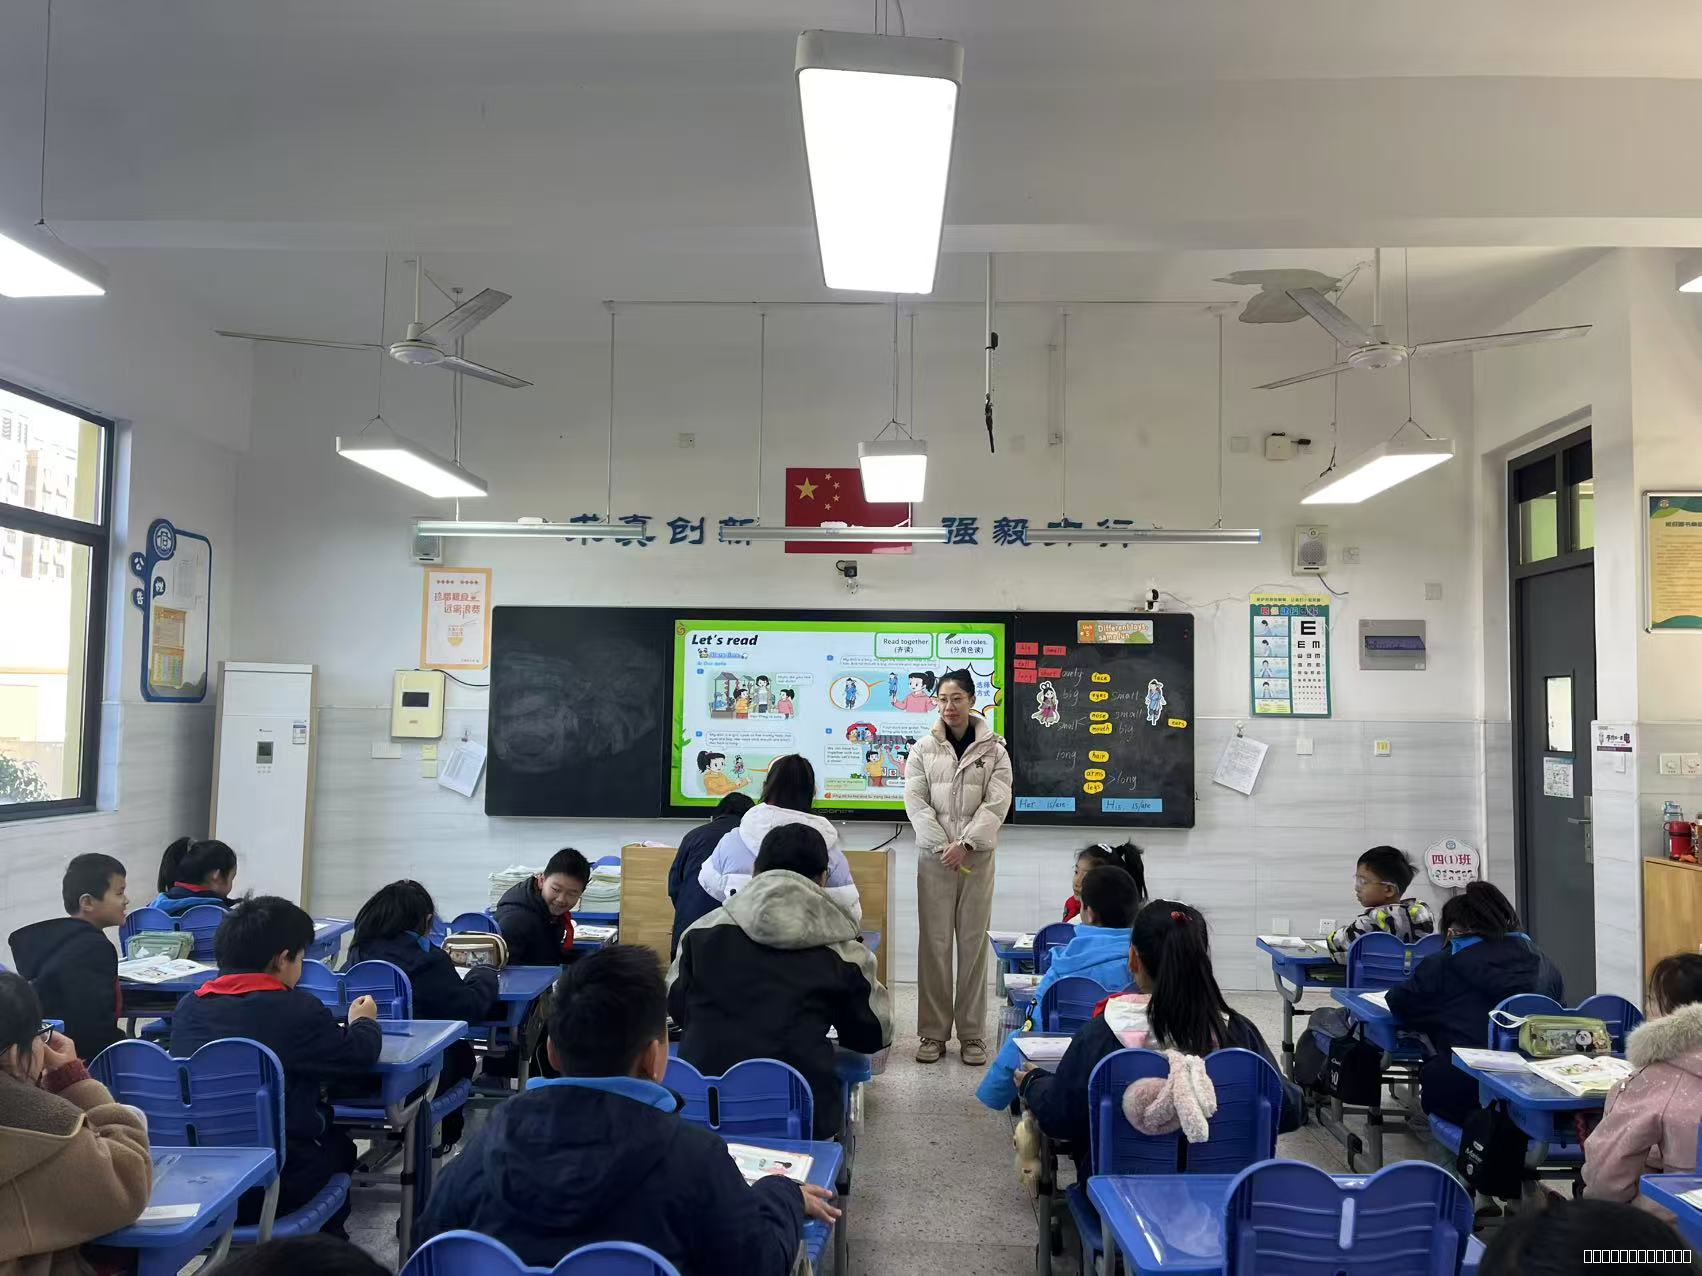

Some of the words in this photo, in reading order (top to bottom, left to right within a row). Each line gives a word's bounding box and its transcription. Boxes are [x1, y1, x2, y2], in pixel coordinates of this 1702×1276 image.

[1097, 623, 1129, 633] Different
[691, 634, 723, 645] Let's
[726, 634, 759, 646] read
[900, 638, 928, 647] together
[1061, 666, 1083, 687] ovely
[1093, 672, 1108, 681] face
[1063, 688, 1079, 706] big
[1091, 724, 1110, 732] mouth
[1056, 751, 1077, 770] long
[1091, 751, 1106, 759] hair
[1117, 770, 1137, 791] long
[1086, 783, 1101, 792] legs
[1432, 853, 1472, 866] 四(1)班
